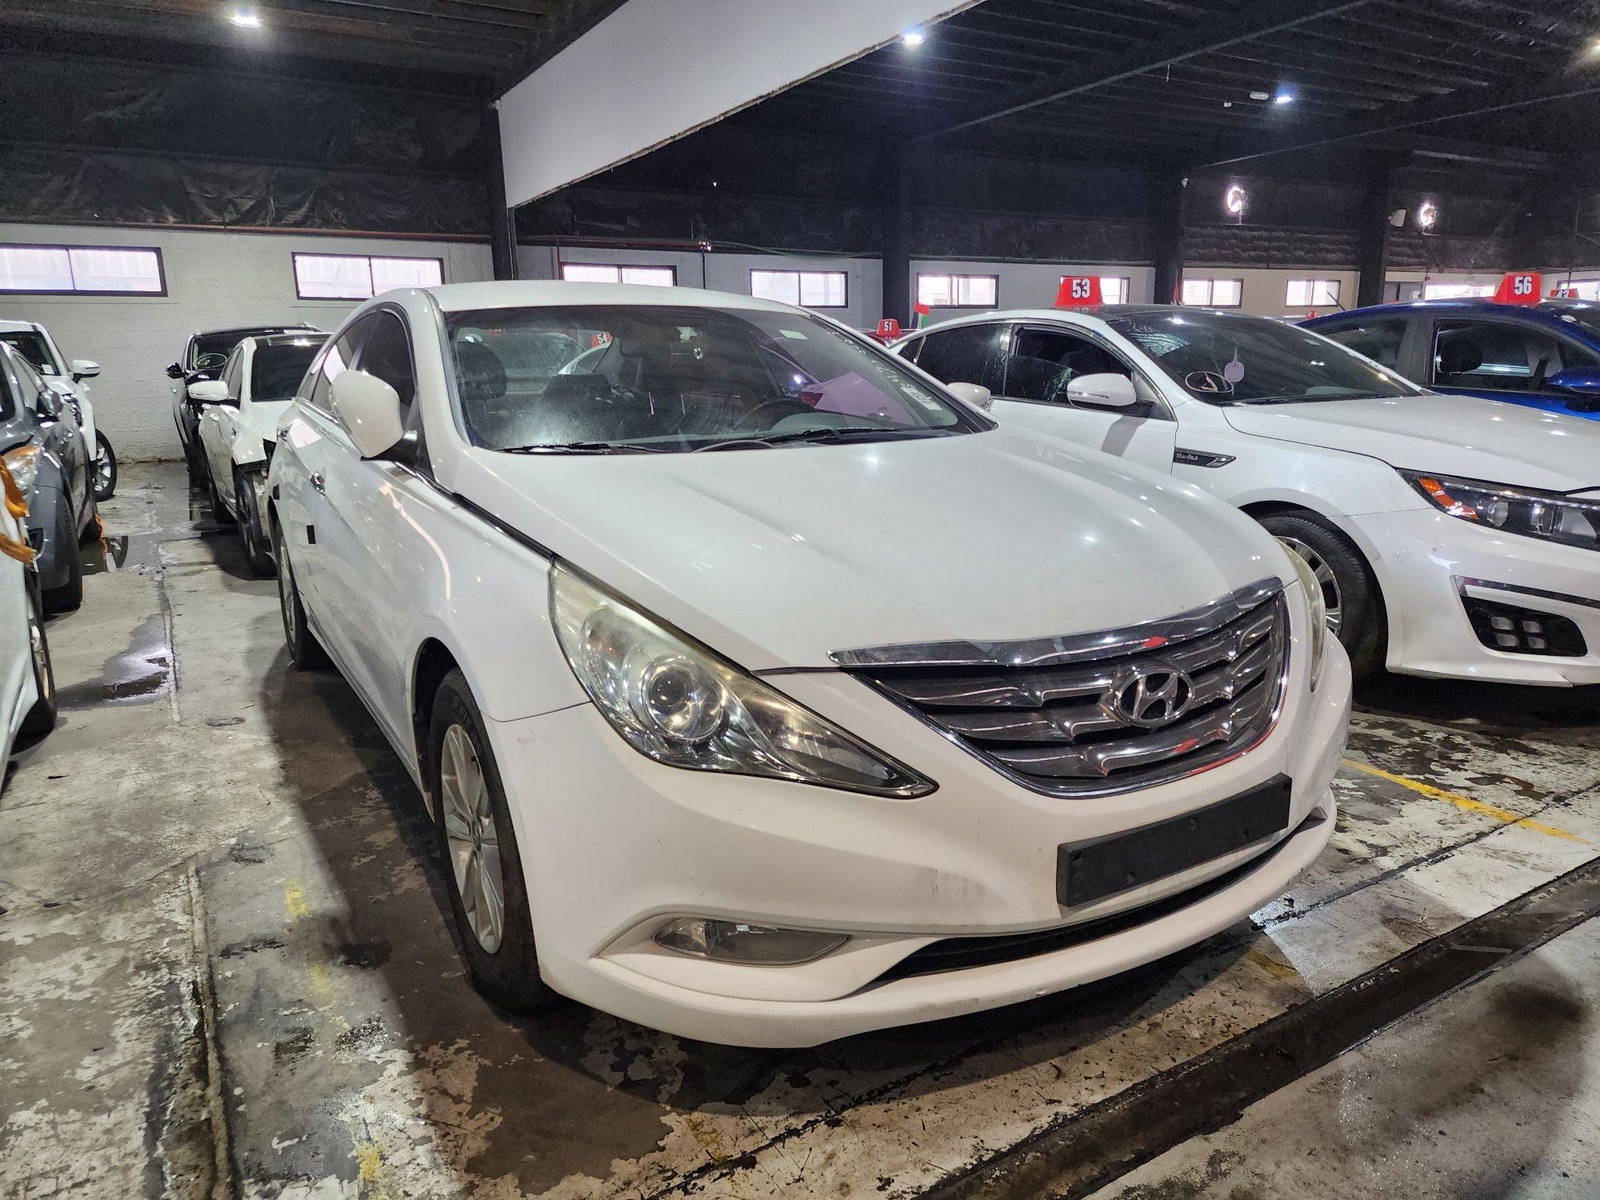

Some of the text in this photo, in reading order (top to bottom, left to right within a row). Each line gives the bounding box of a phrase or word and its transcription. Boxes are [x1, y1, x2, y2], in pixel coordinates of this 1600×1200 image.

[1072, 279, 1090, 299] 53
[1514, 276, 1532, 295] 56
[884, 321, 892, 332] 51
